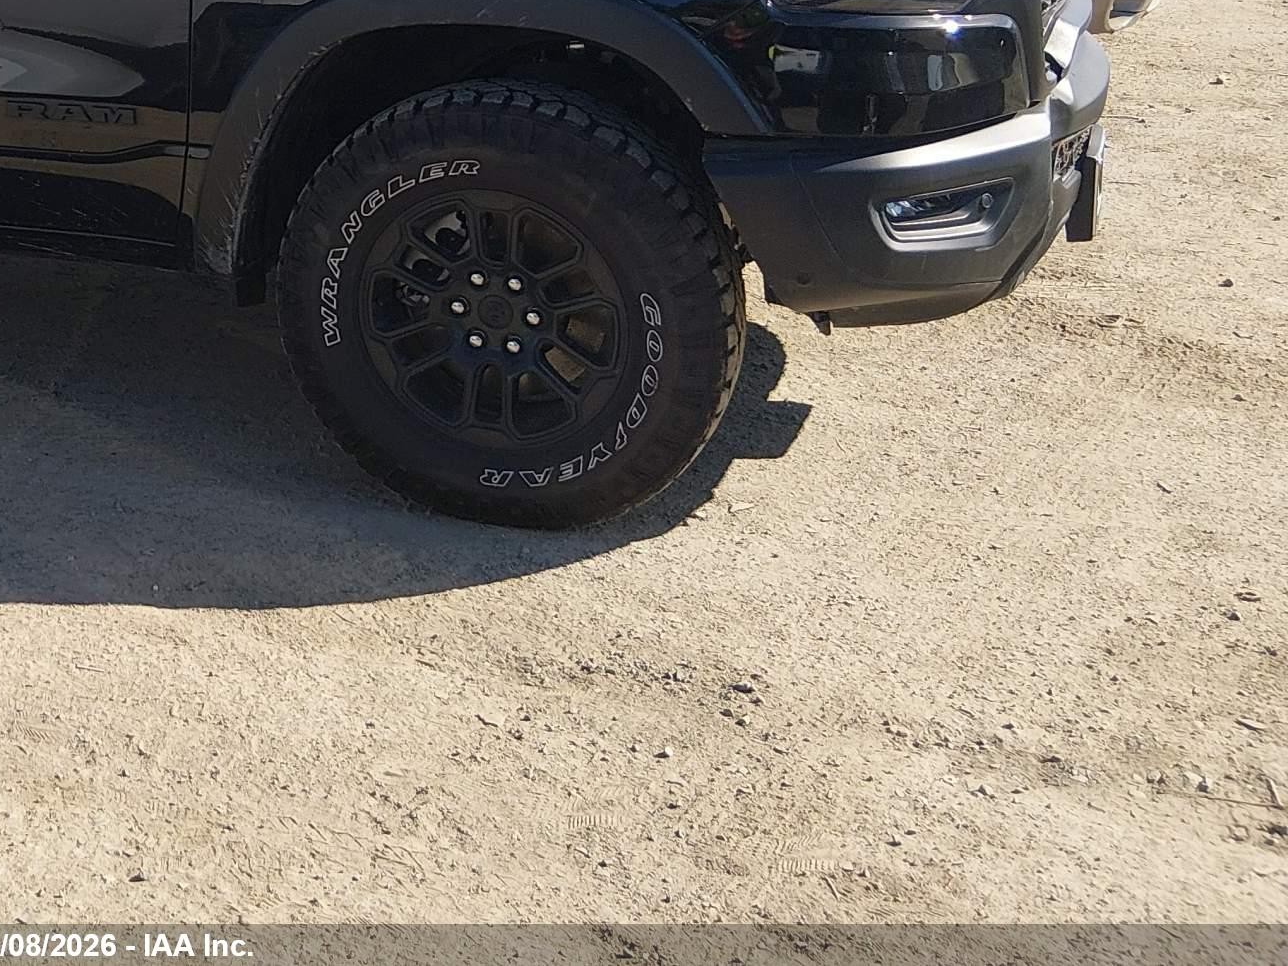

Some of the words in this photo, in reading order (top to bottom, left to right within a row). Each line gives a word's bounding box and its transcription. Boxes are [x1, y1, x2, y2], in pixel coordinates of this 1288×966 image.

[7, 99, 137, 125] RAM
[318, 158, 482, 347] WRANGLER
[478, 291, 663, 489] GOODYEAR
